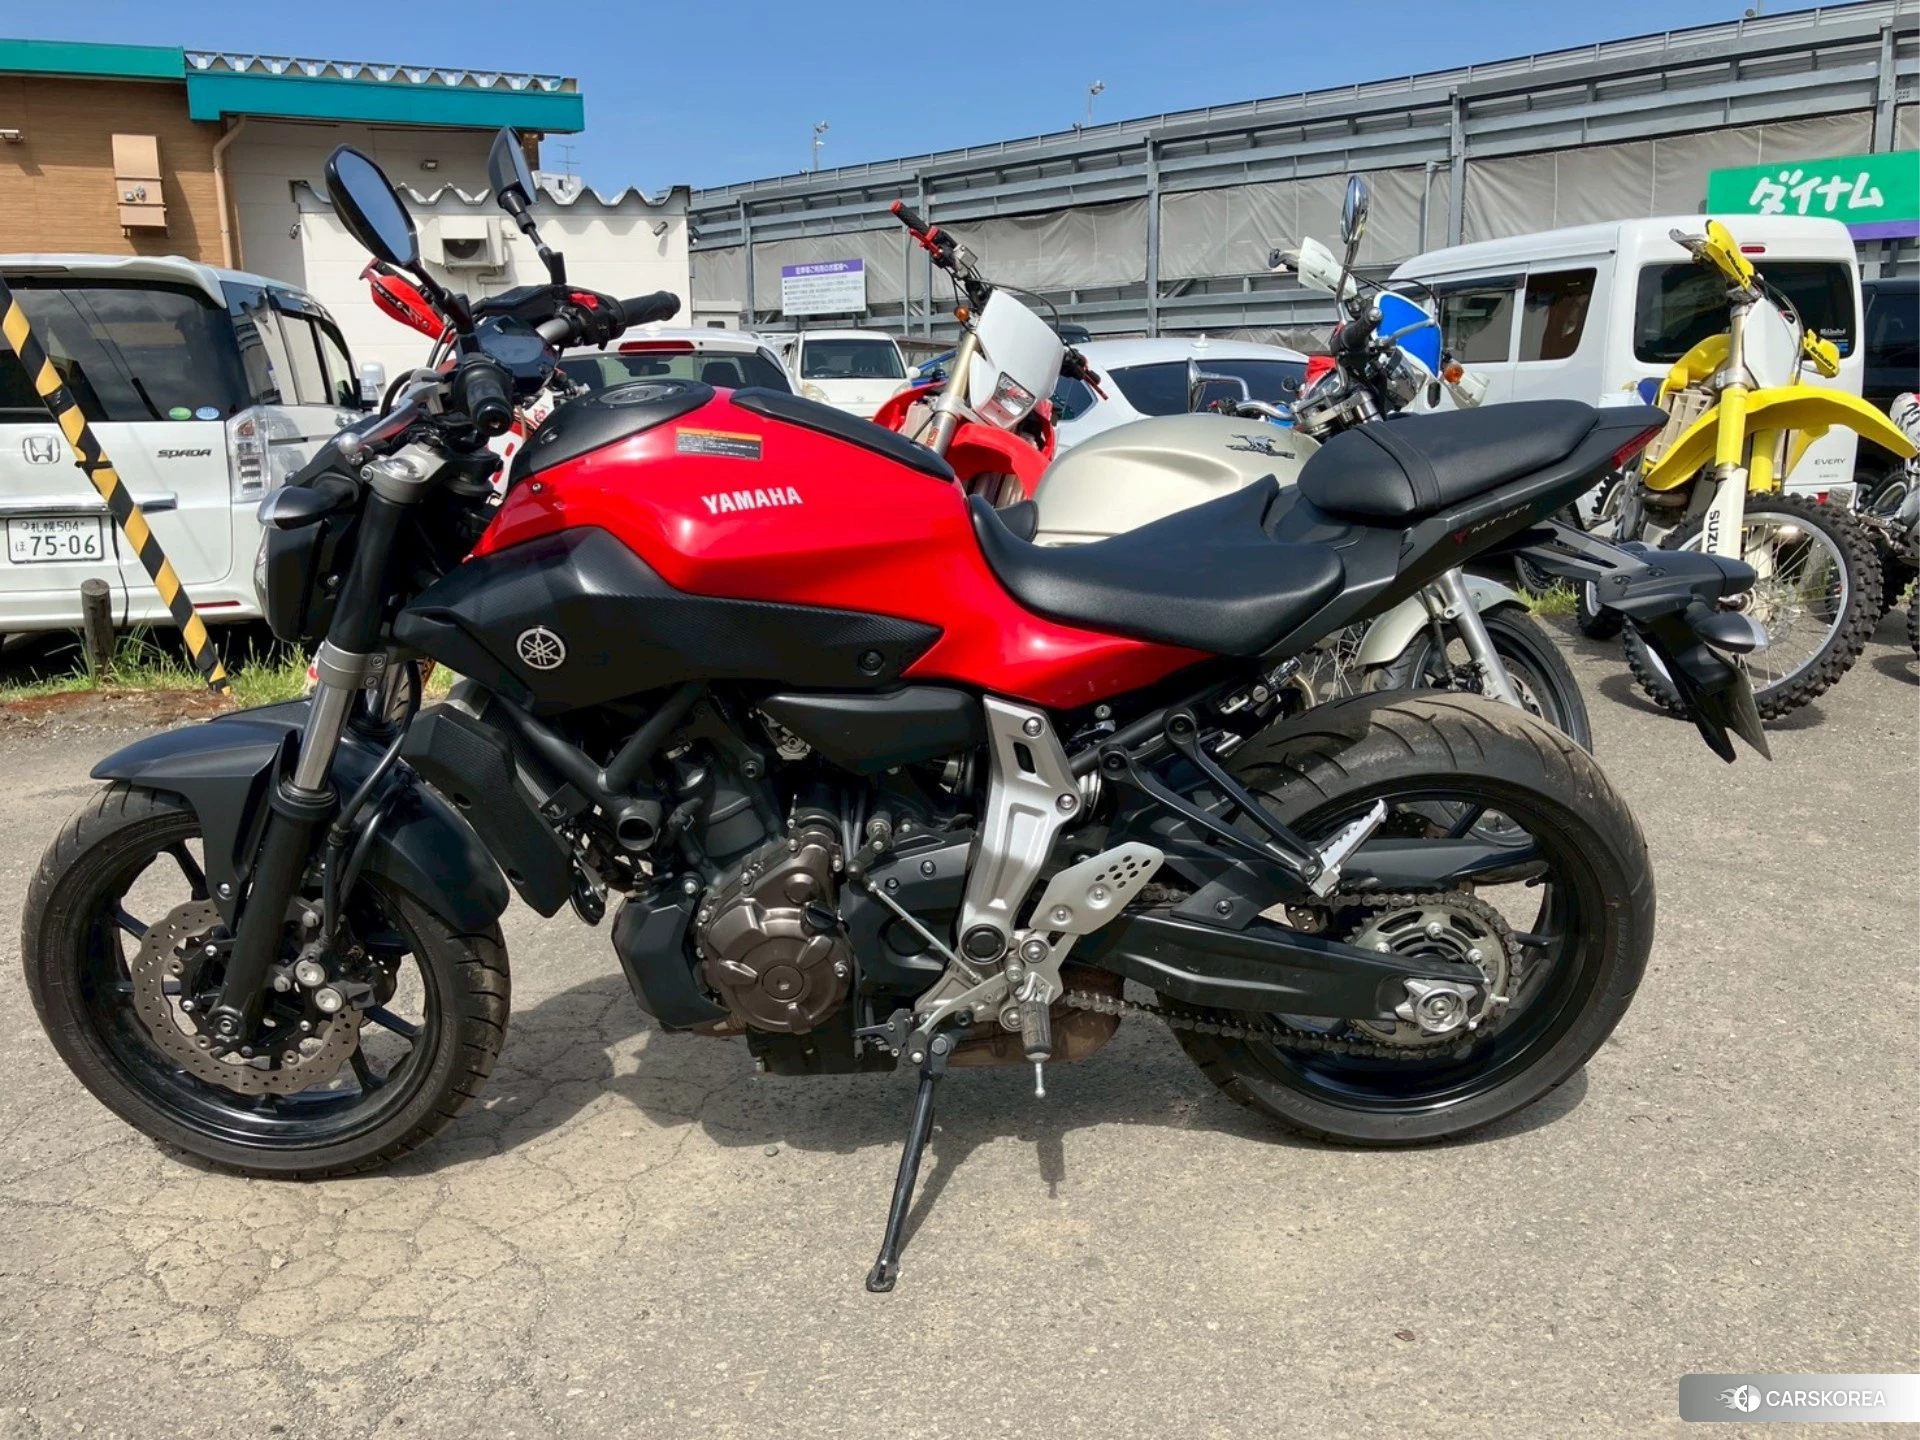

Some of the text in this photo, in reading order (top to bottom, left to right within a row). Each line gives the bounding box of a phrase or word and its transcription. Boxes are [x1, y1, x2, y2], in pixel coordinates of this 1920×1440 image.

[1749, 169, 1885, 215] ダイナム
[157, 448, 212, 459] SPADA
[701, 486, 803, 515] YAMAHA
[30, 534, 96, 556] 75-06
